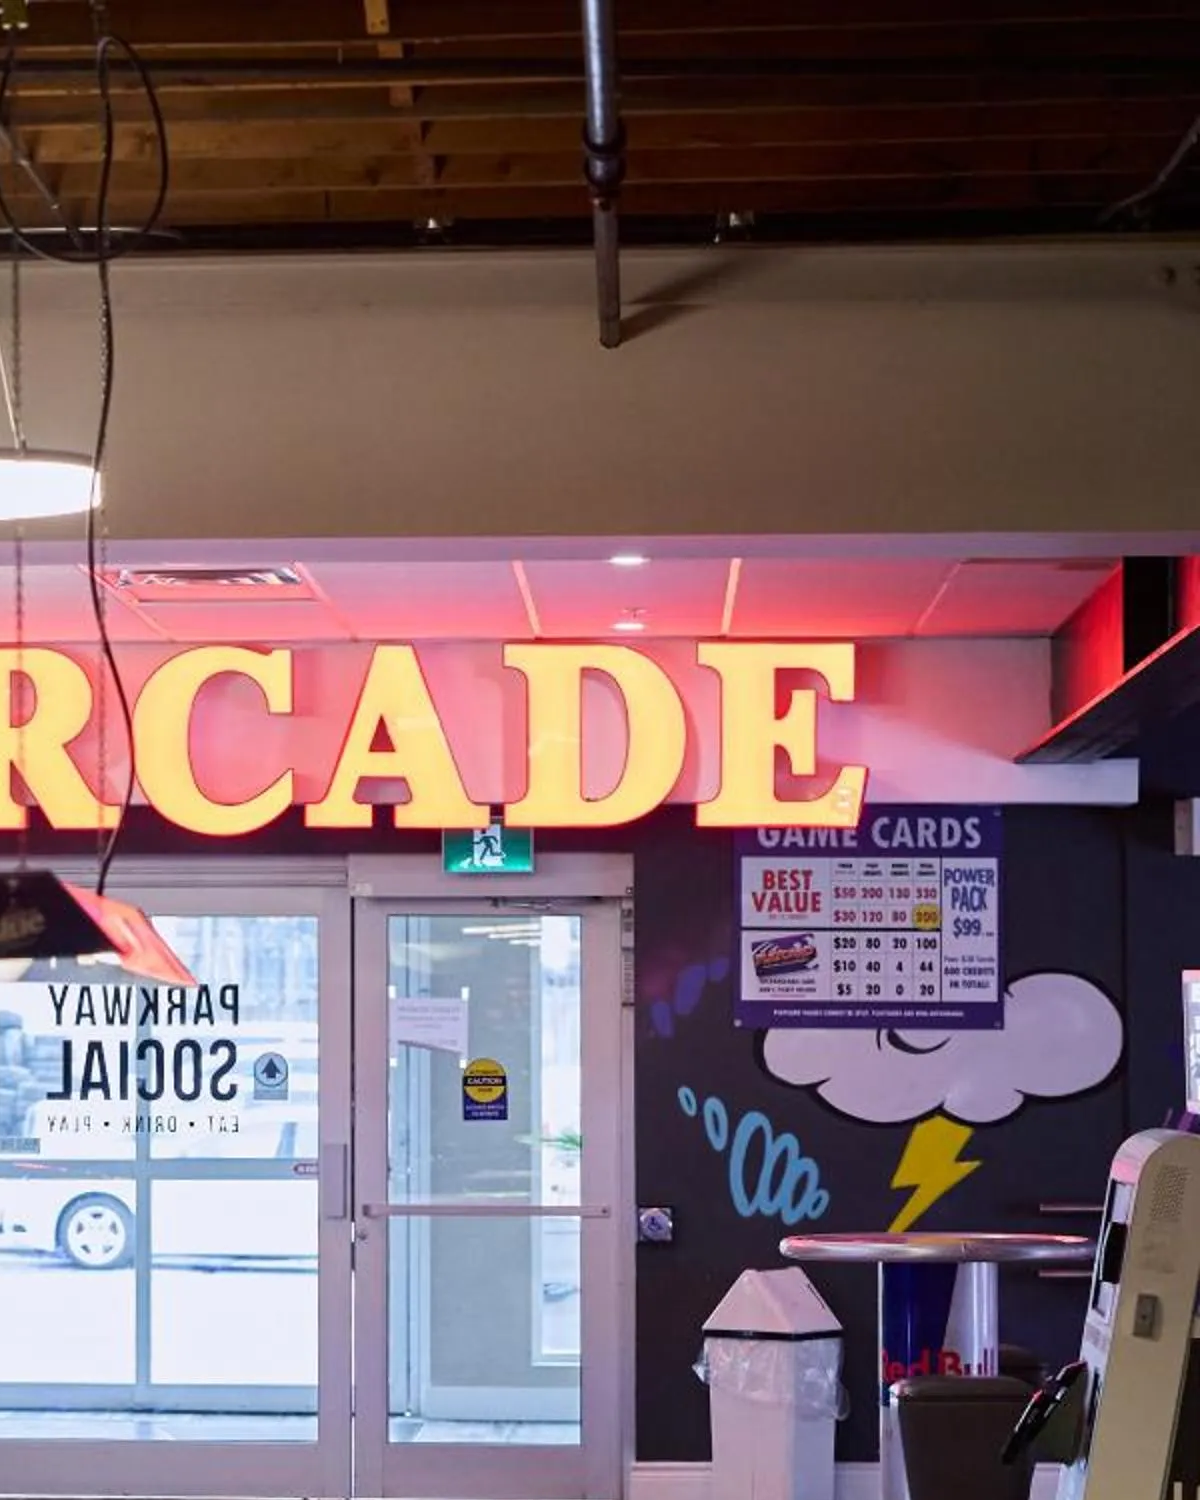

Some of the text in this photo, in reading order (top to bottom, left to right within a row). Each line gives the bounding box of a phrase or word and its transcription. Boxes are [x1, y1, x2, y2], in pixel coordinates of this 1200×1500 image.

[871, 816, 982, 849] CARDS
[762, 869, 813, 890] BEST
[943, 867, 995, 887] POWER
[751, 891, 822, 912] VALUE
[861, 886, 883, 899] 200
[951, 886, 988, 912] PACK
[862, 910, 883, 922] 120
[953, 917, 982, 938] $99
[833, 937, 856, 949] $20
[892, 937, 907, 949] 20
[916, 938, 937, 949] 100
[833, 960, 933, 972] $10 40 4 44
[837, 983, 935, 995] $5 20 0 20
[938, 1347, 997, 1376] Bull
